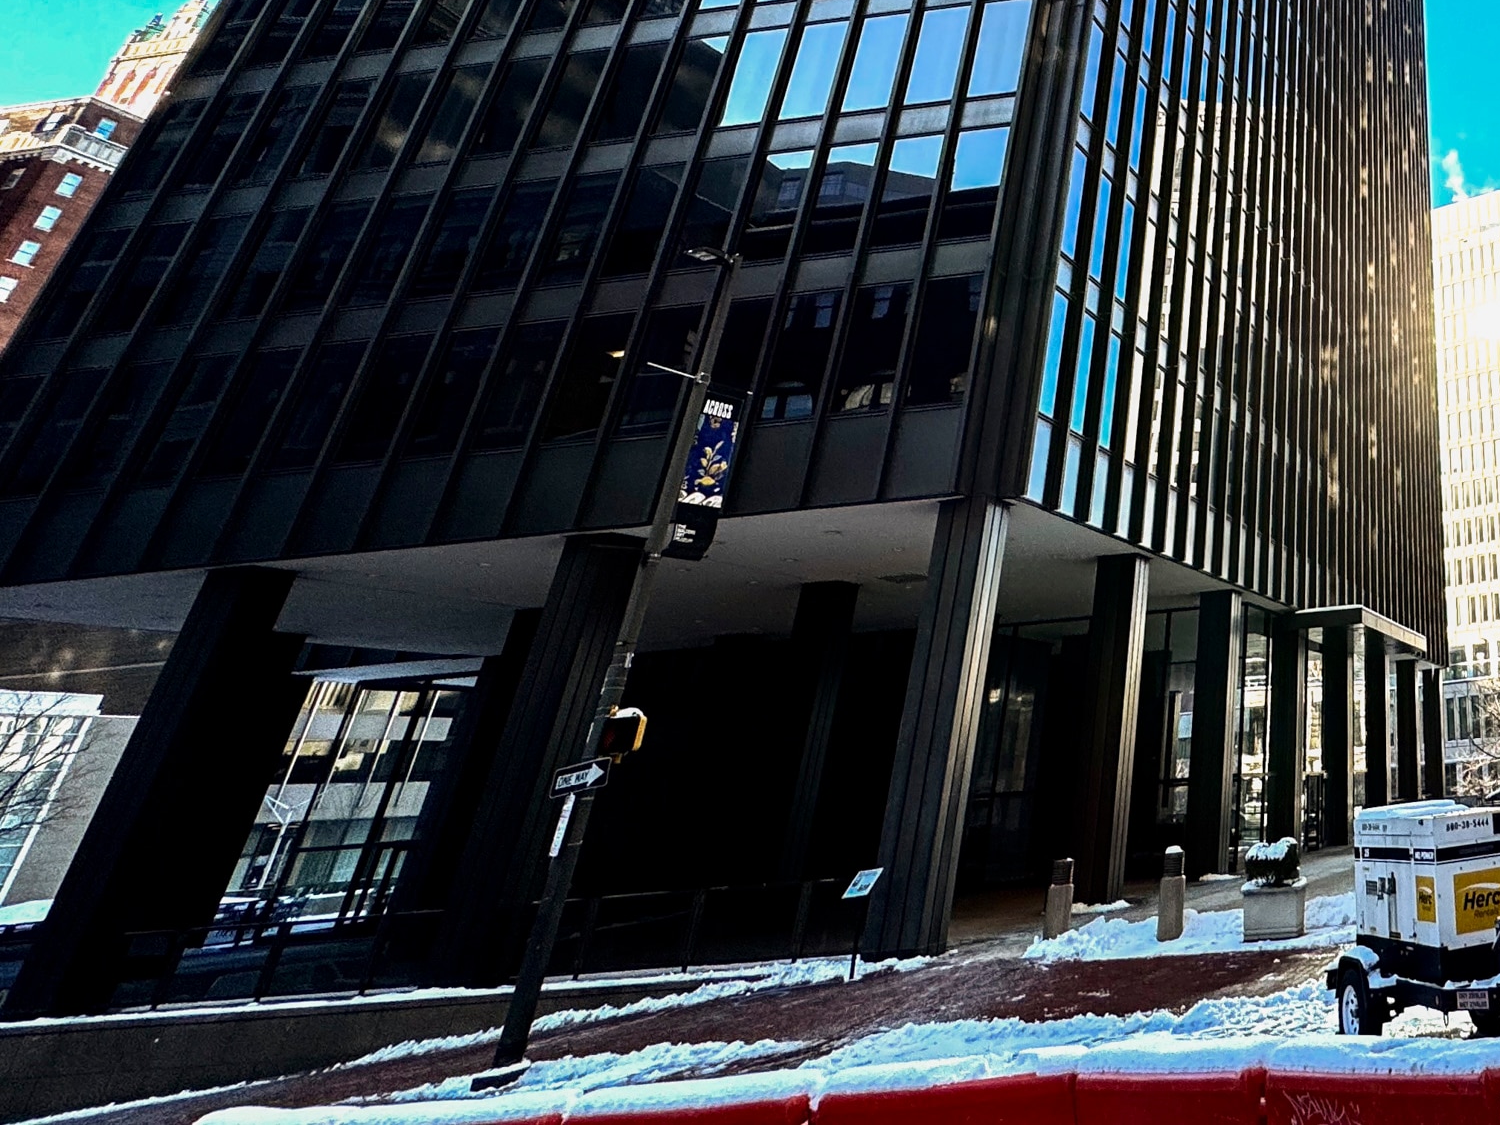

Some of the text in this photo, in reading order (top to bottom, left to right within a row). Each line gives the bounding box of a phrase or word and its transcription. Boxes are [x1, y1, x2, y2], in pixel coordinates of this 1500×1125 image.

[703, 399, 734, 420] ACROSS
[557, 771, 589, 788] ONE WAY
[1474, 908, 1500, 918] Rentals
